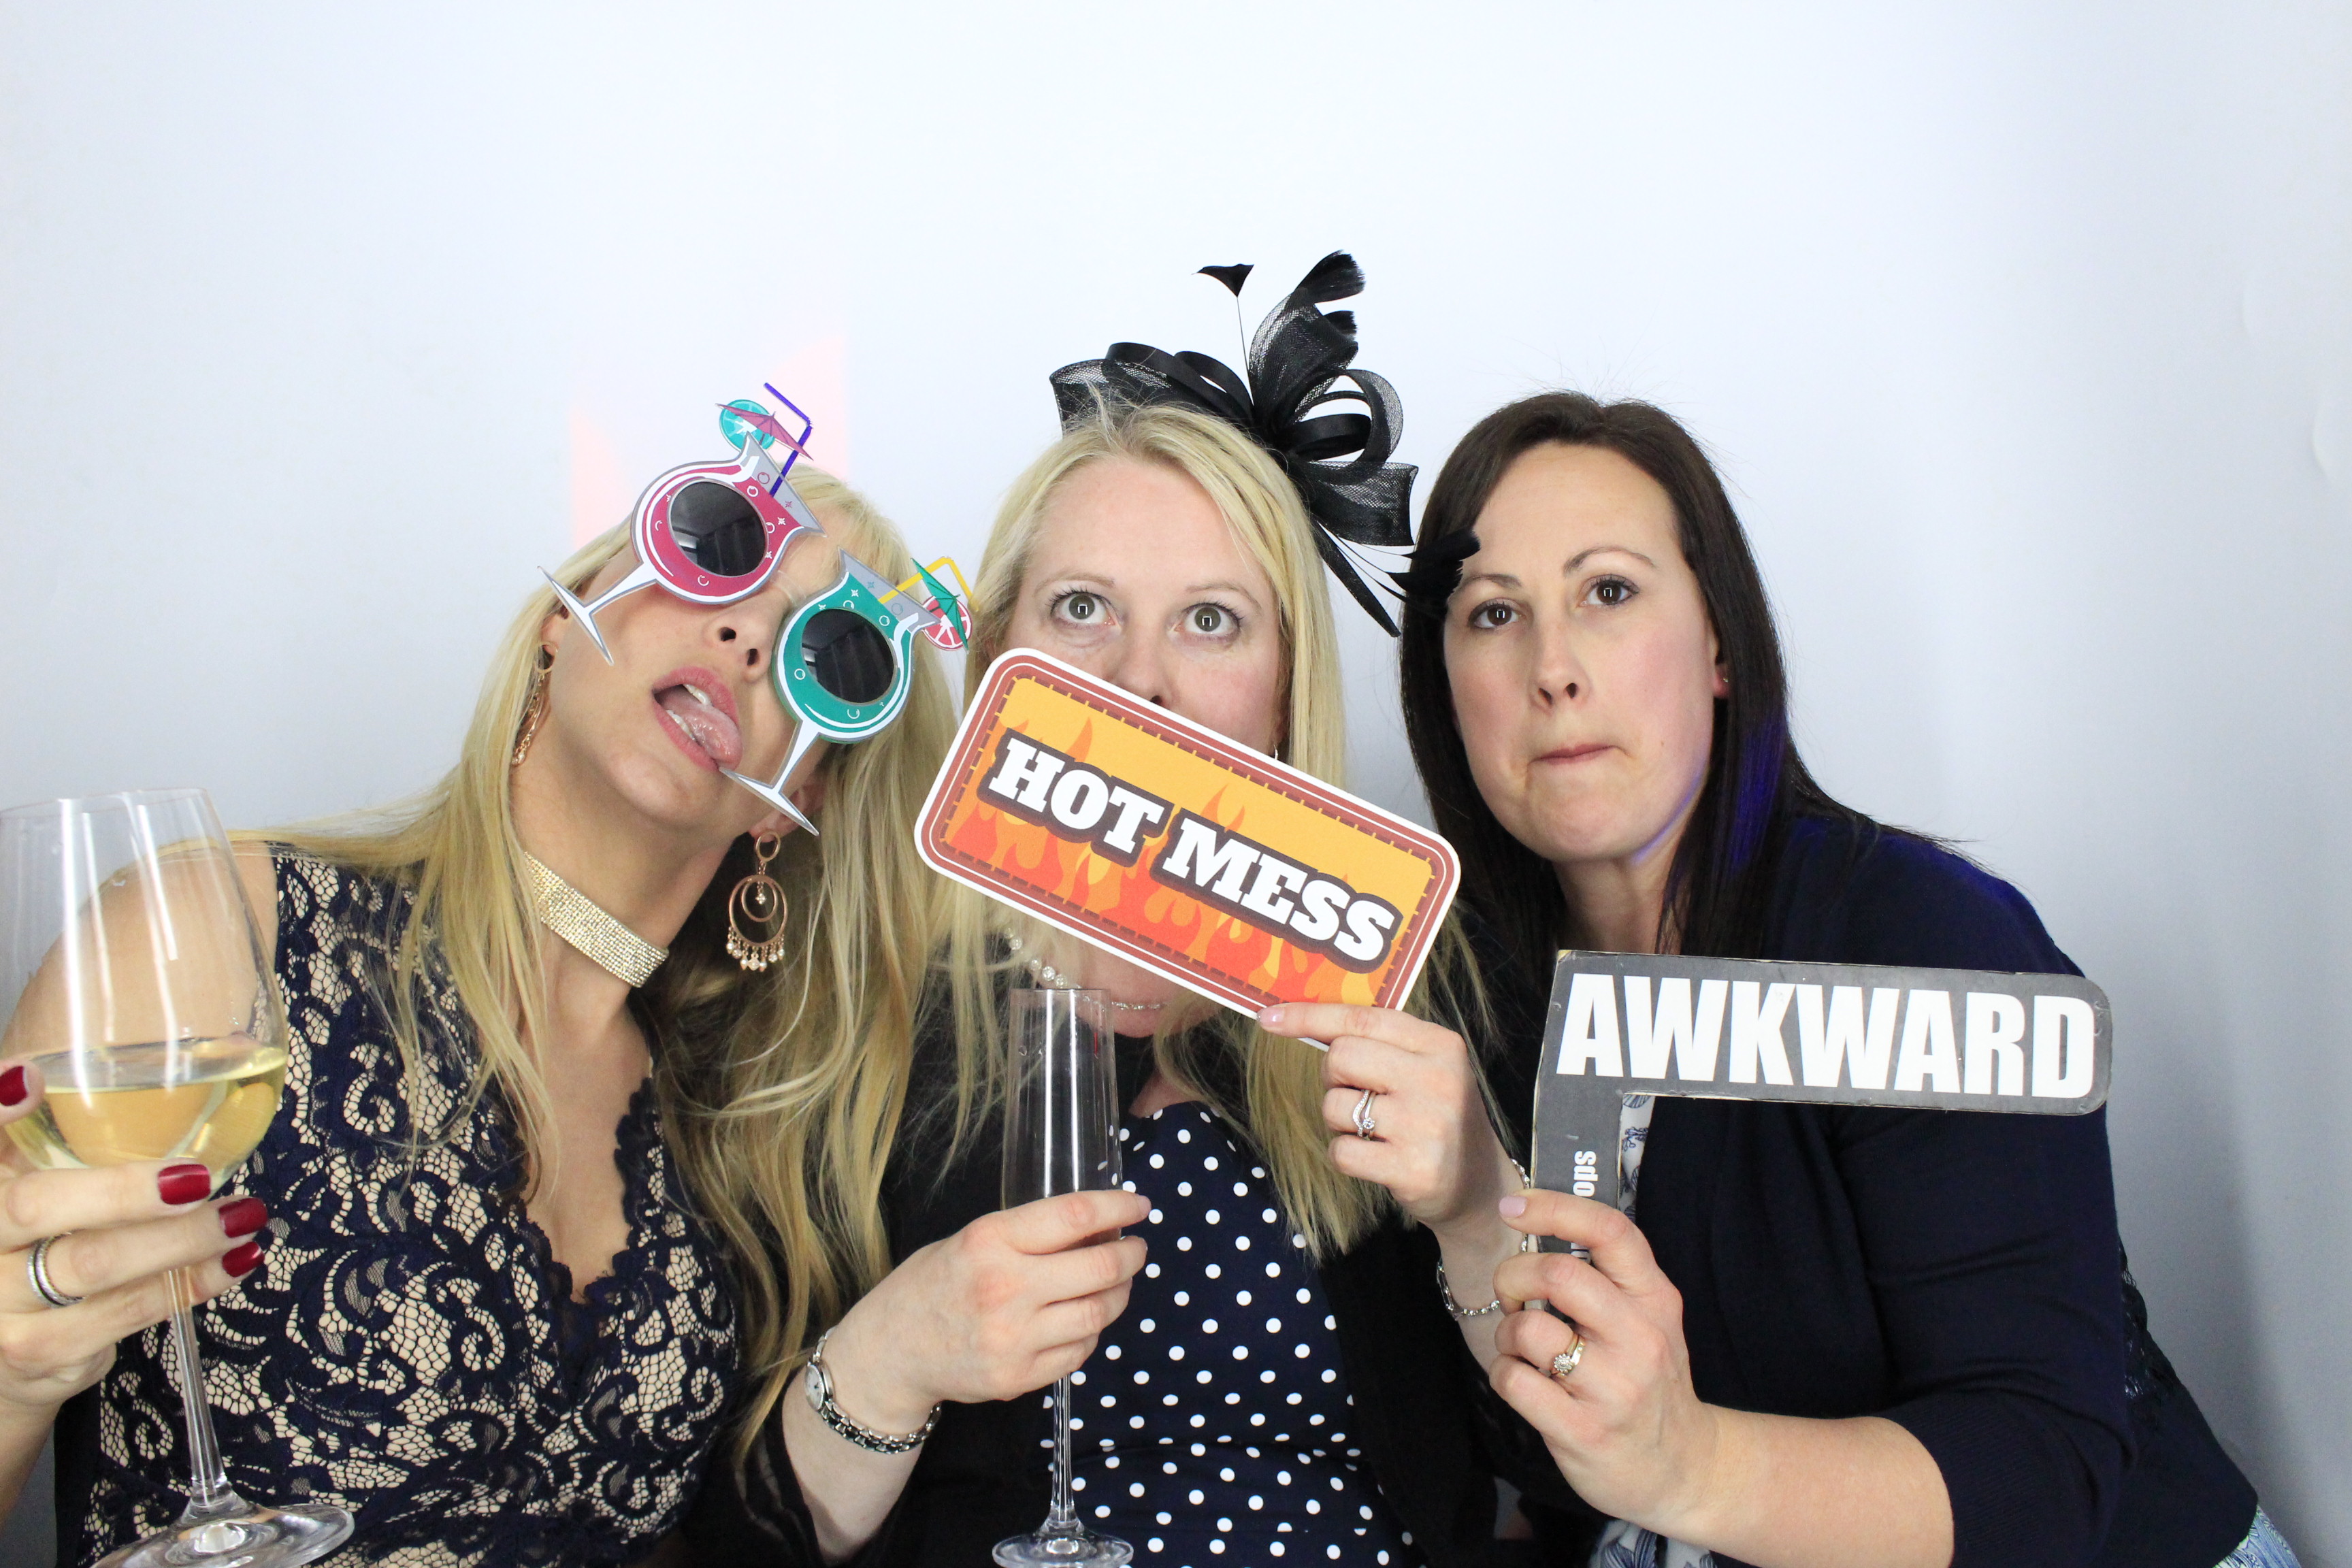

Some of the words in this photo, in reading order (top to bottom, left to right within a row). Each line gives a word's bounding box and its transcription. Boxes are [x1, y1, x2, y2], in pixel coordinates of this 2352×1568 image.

[987, 736, 1166, 855] HOT
[1161, 817, 1396, 962] MESS
[1556, 973, 2098, 1100] AWKWARD
[1573, 1150, 1599, 1198] ops
